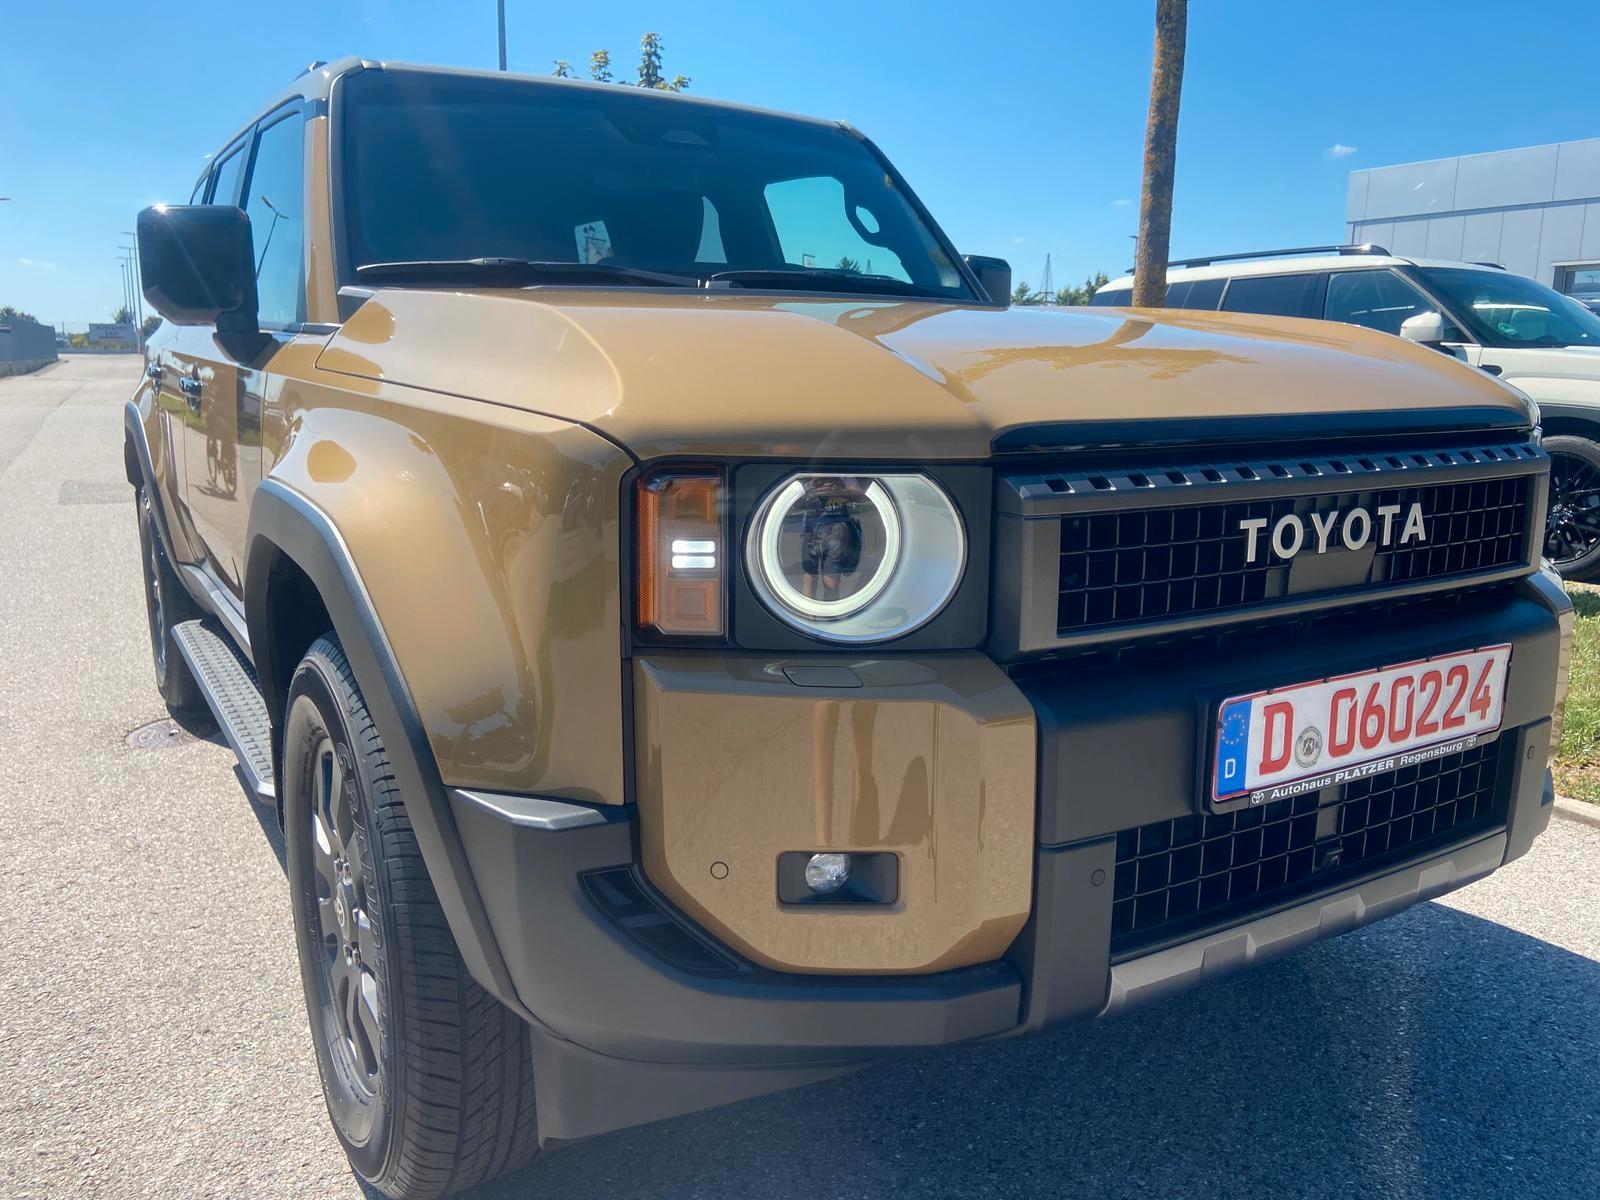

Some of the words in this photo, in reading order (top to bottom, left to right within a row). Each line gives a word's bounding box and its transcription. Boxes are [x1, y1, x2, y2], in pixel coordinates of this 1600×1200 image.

[1240, 502, 1426, 563] TOYOTA
[1259, 701, 1294, 776] D
[1328, 658, 1495, 758] 060224
[1224, 758, 1236, 779] D
[1270, 776, 1332, 800] Autohaus
[1335, 759, 1394, 783] PLATZER
[1400, 740, 1463, 766] Regensburg
